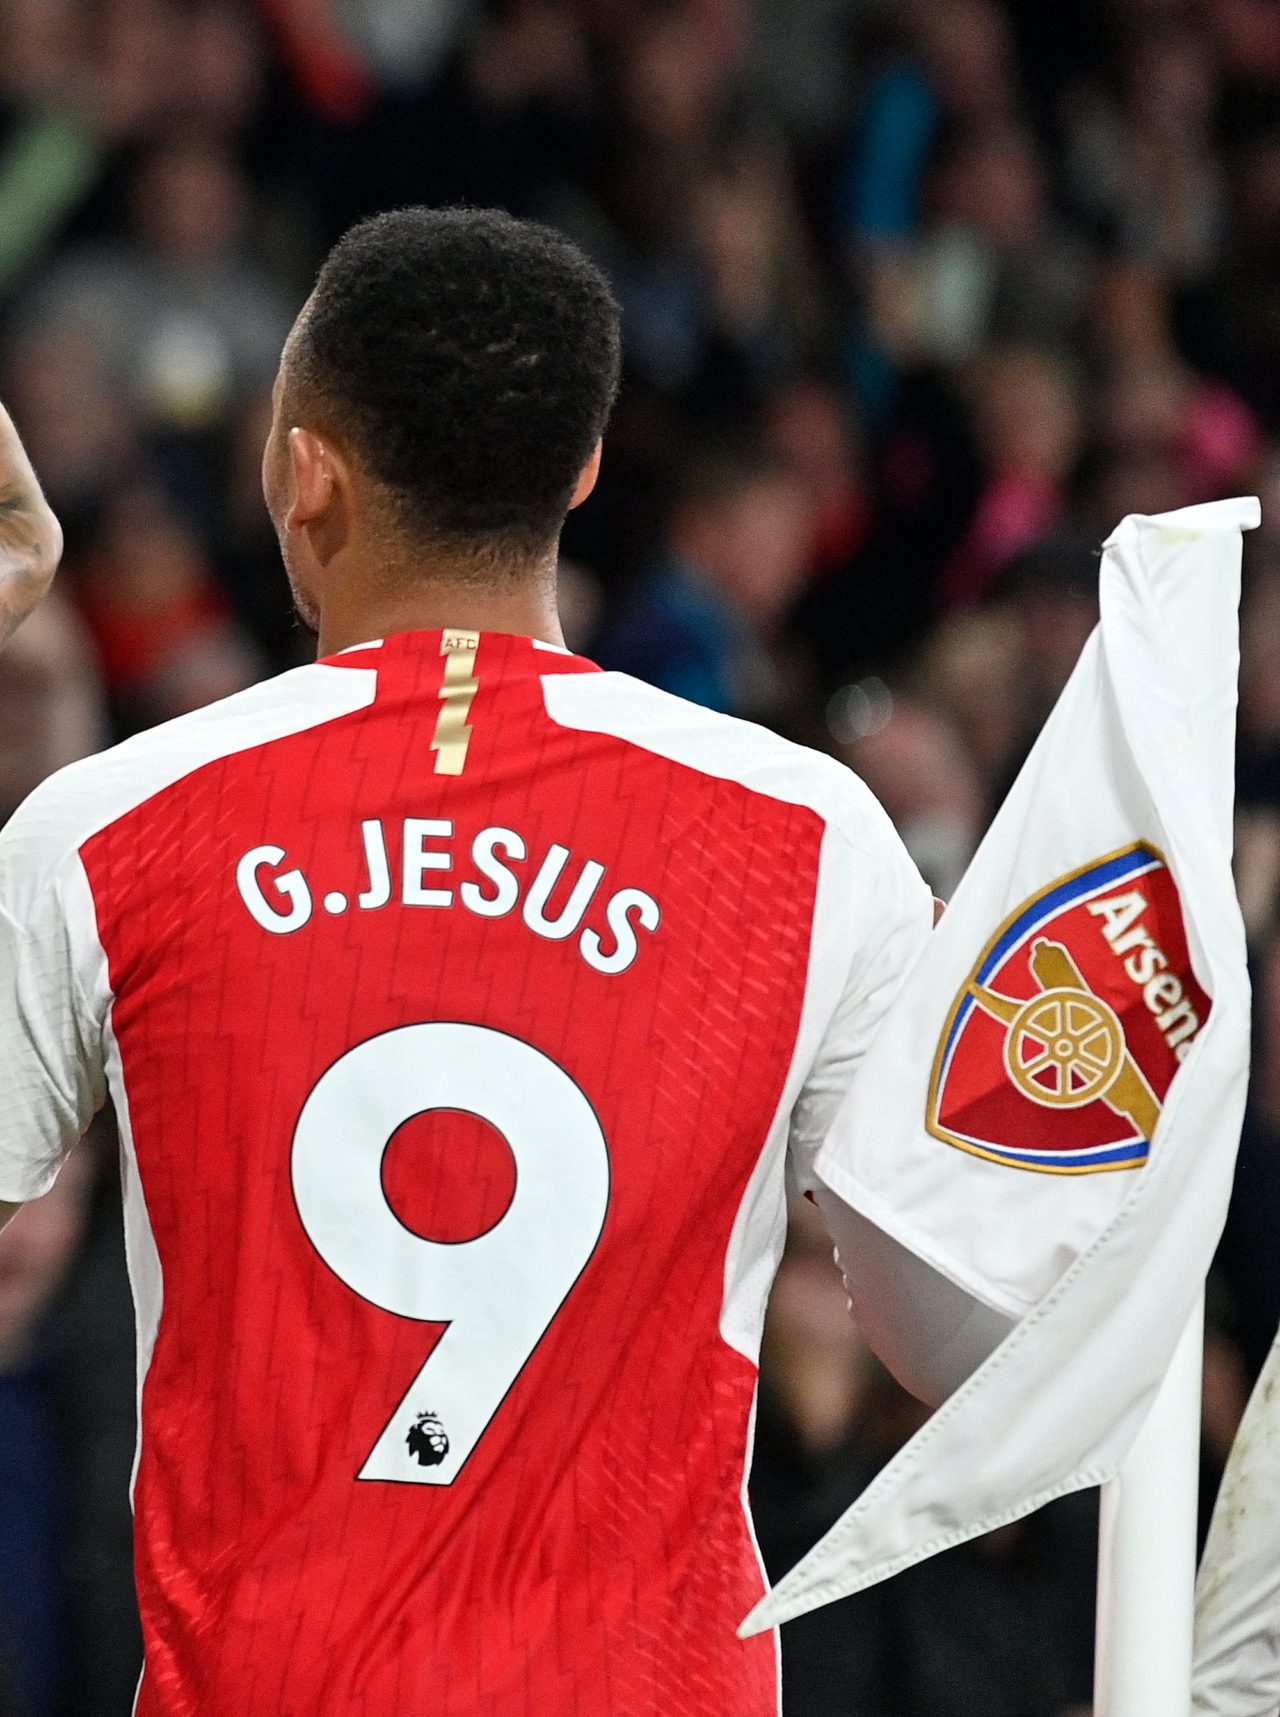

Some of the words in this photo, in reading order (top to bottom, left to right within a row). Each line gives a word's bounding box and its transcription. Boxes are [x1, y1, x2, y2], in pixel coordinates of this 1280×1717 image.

[444, 637, 477, 650] AFC
[236, 817, 661, 976] G.JESUS
[290, 1020, 611, 1486] 9
